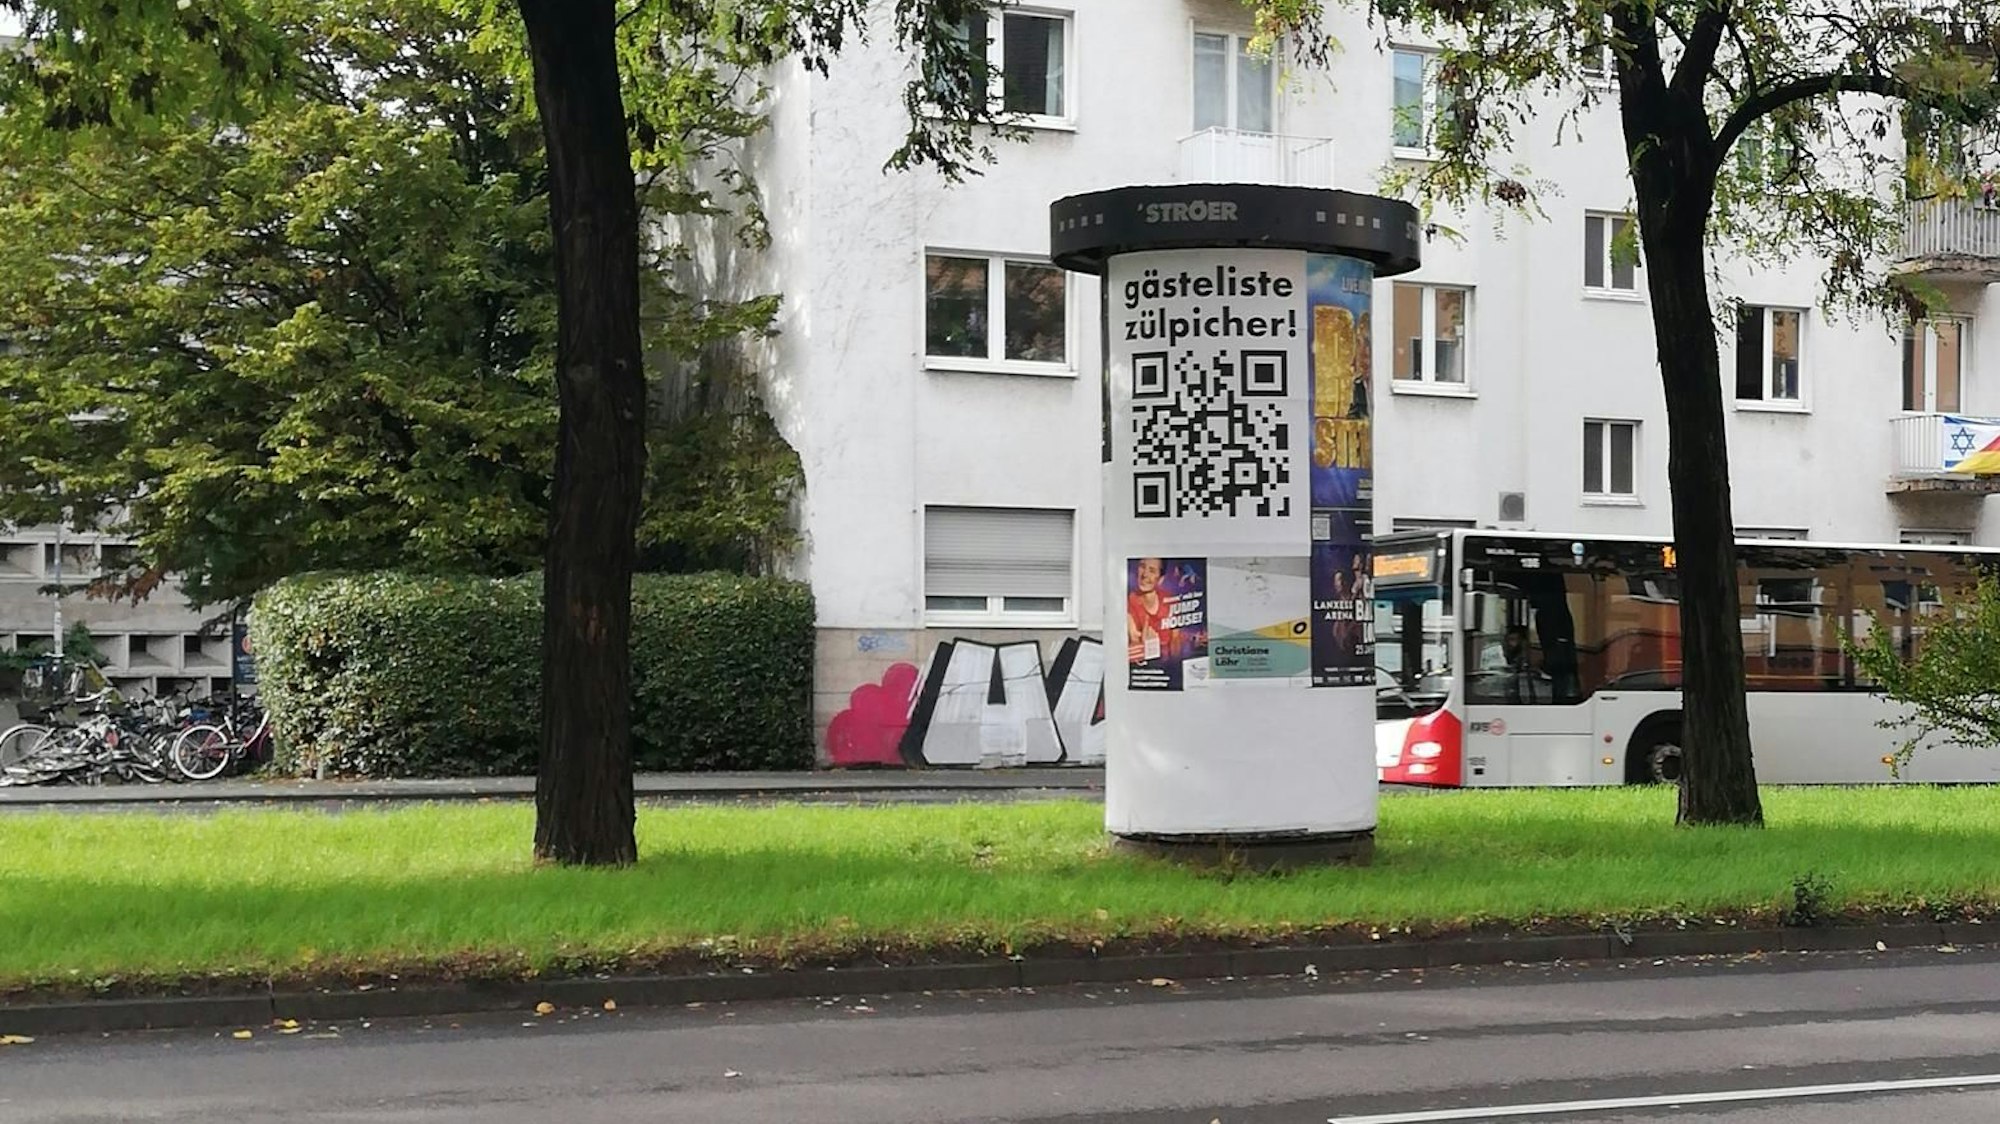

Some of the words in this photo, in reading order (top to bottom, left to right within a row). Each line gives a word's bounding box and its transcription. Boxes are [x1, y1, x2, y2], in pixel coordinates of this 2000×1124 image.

[1125, 265, 1293, 309] gästeliste
[1125, 306, 1297, 347] zülpicher!
[1169, 600, 1200, 617] JUMP
[1161, 612, 1203, 630] HOUSE!
[1215, 646, 1269, 655] Christiane
[1215, 657, 1239, 666] Löhr
